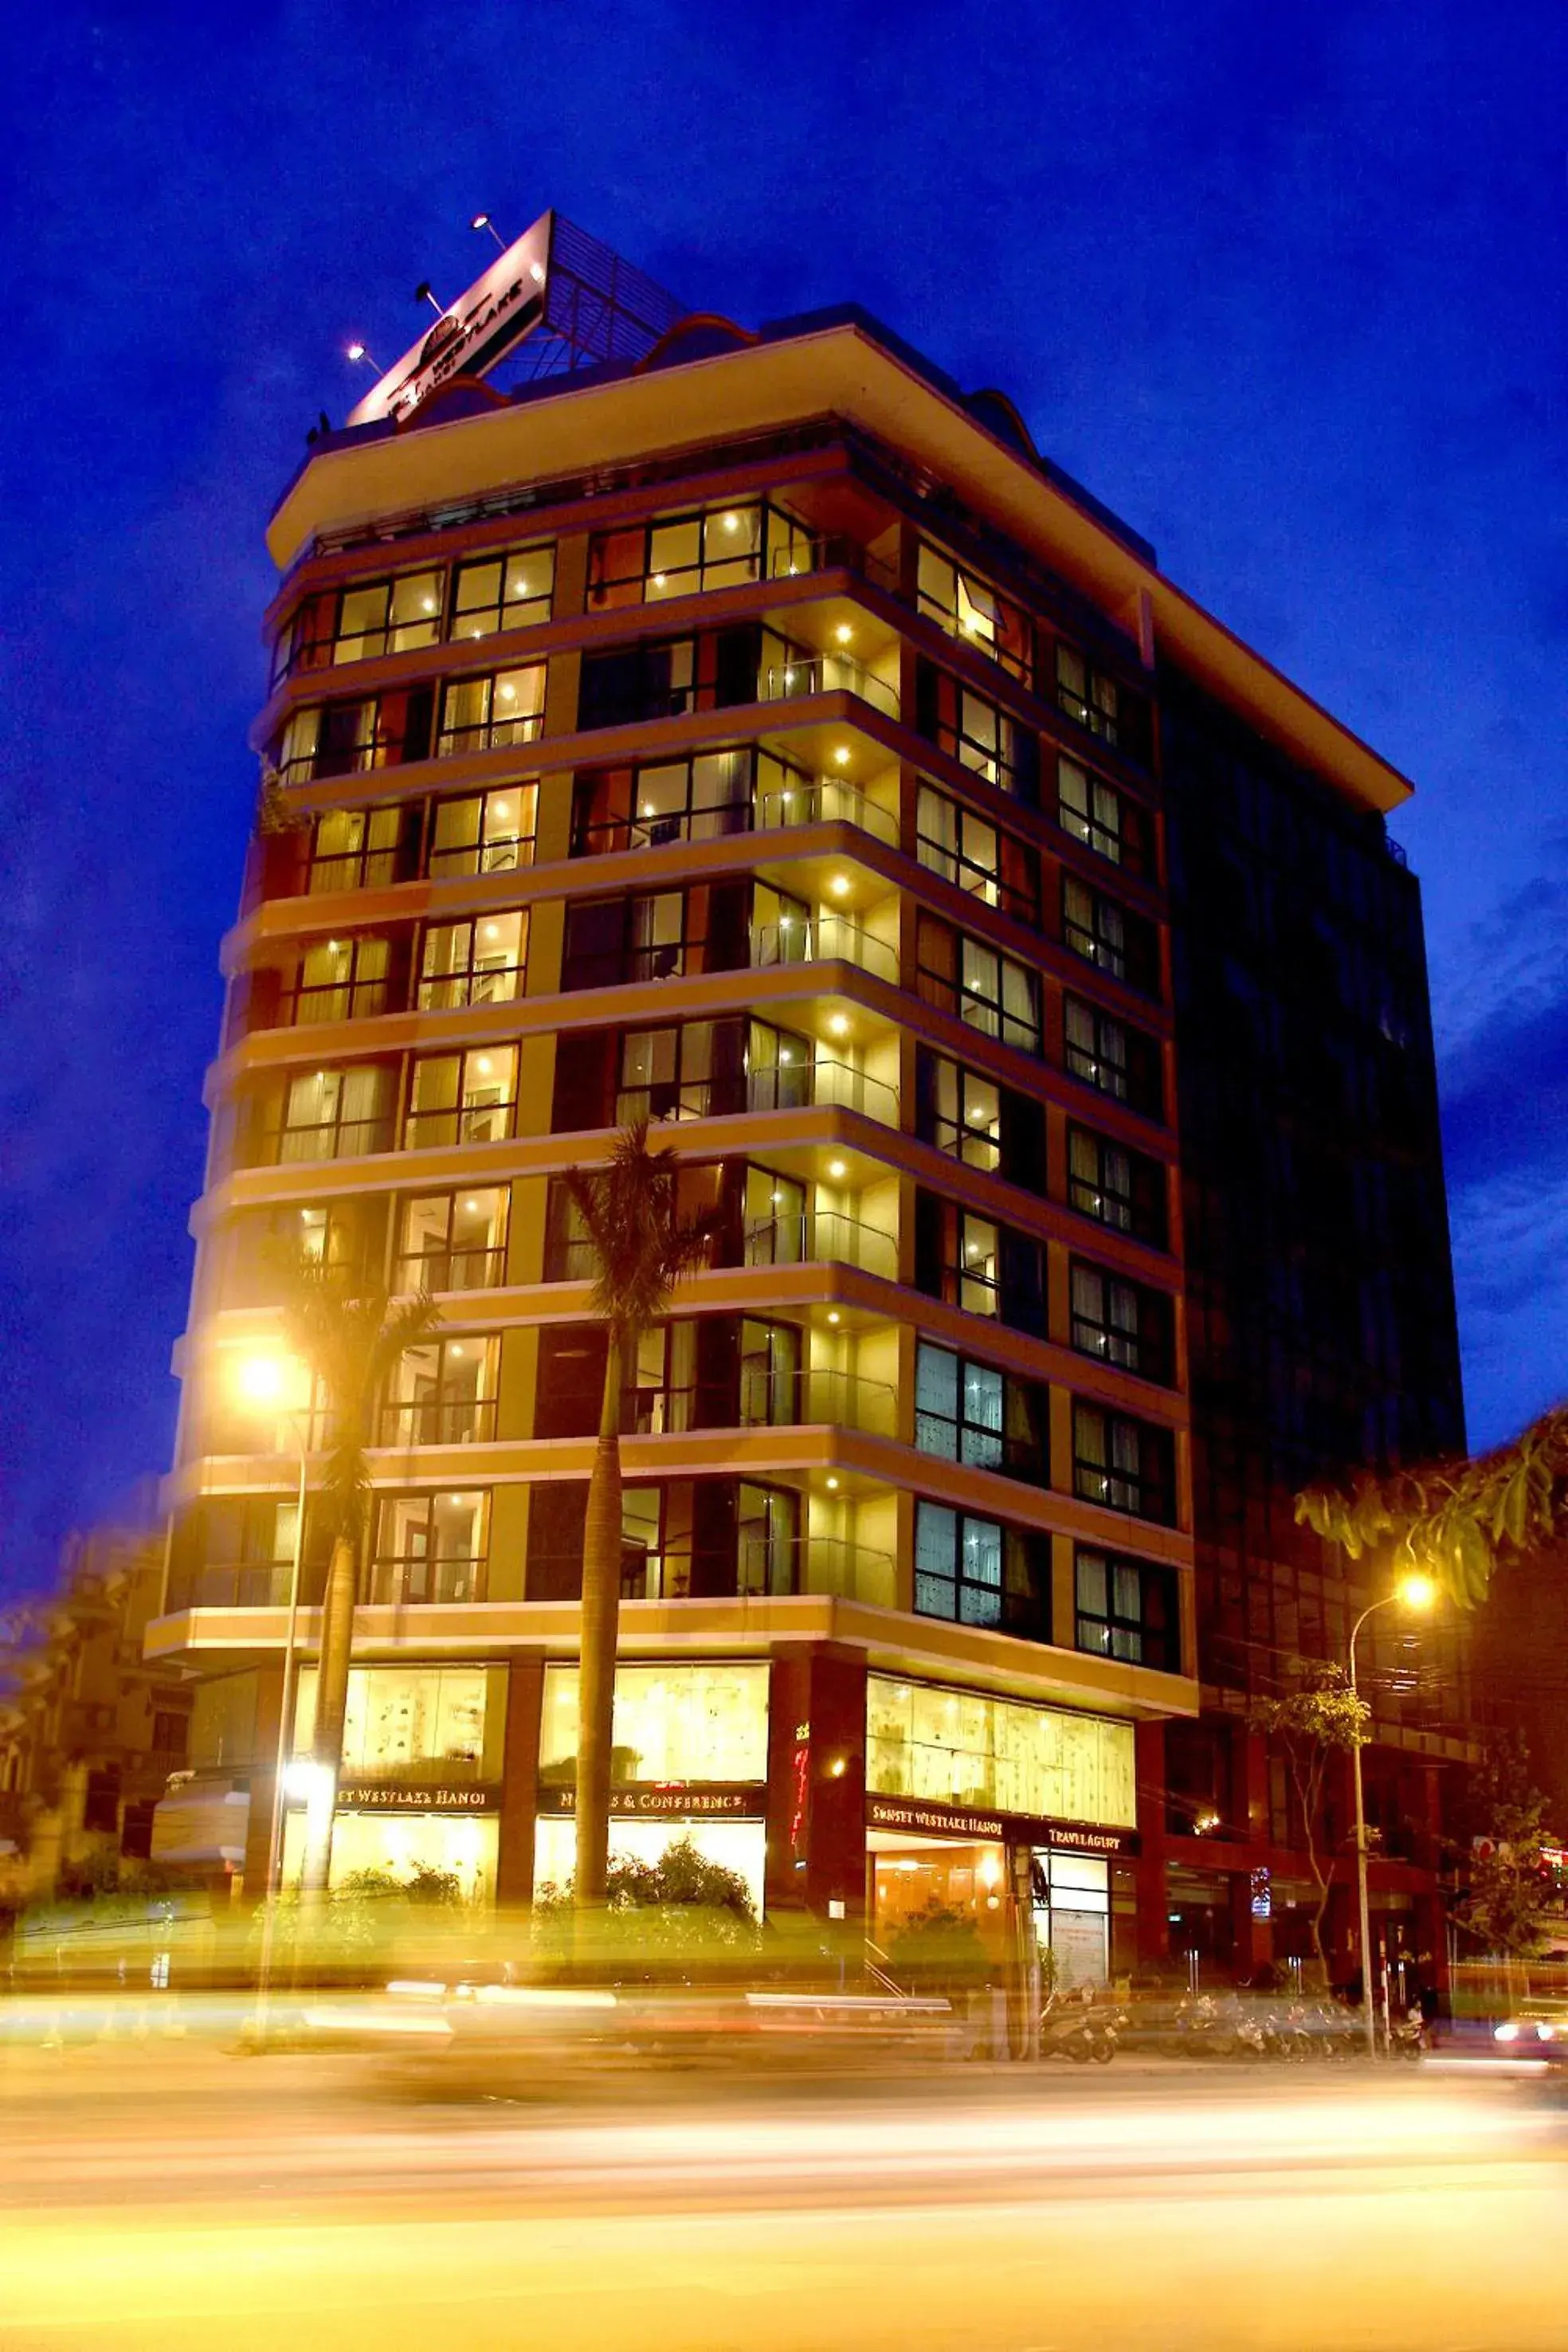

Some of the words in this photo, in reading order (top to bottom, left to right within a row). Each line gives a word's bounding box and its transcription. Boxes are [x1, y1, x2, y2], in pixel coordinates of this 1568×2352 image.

[435, 1789, 486, 1805] HANOI
[915, 1812, 969, 1830] WESTLAKE
[969, 1817, 1003, 1836] HANOI
